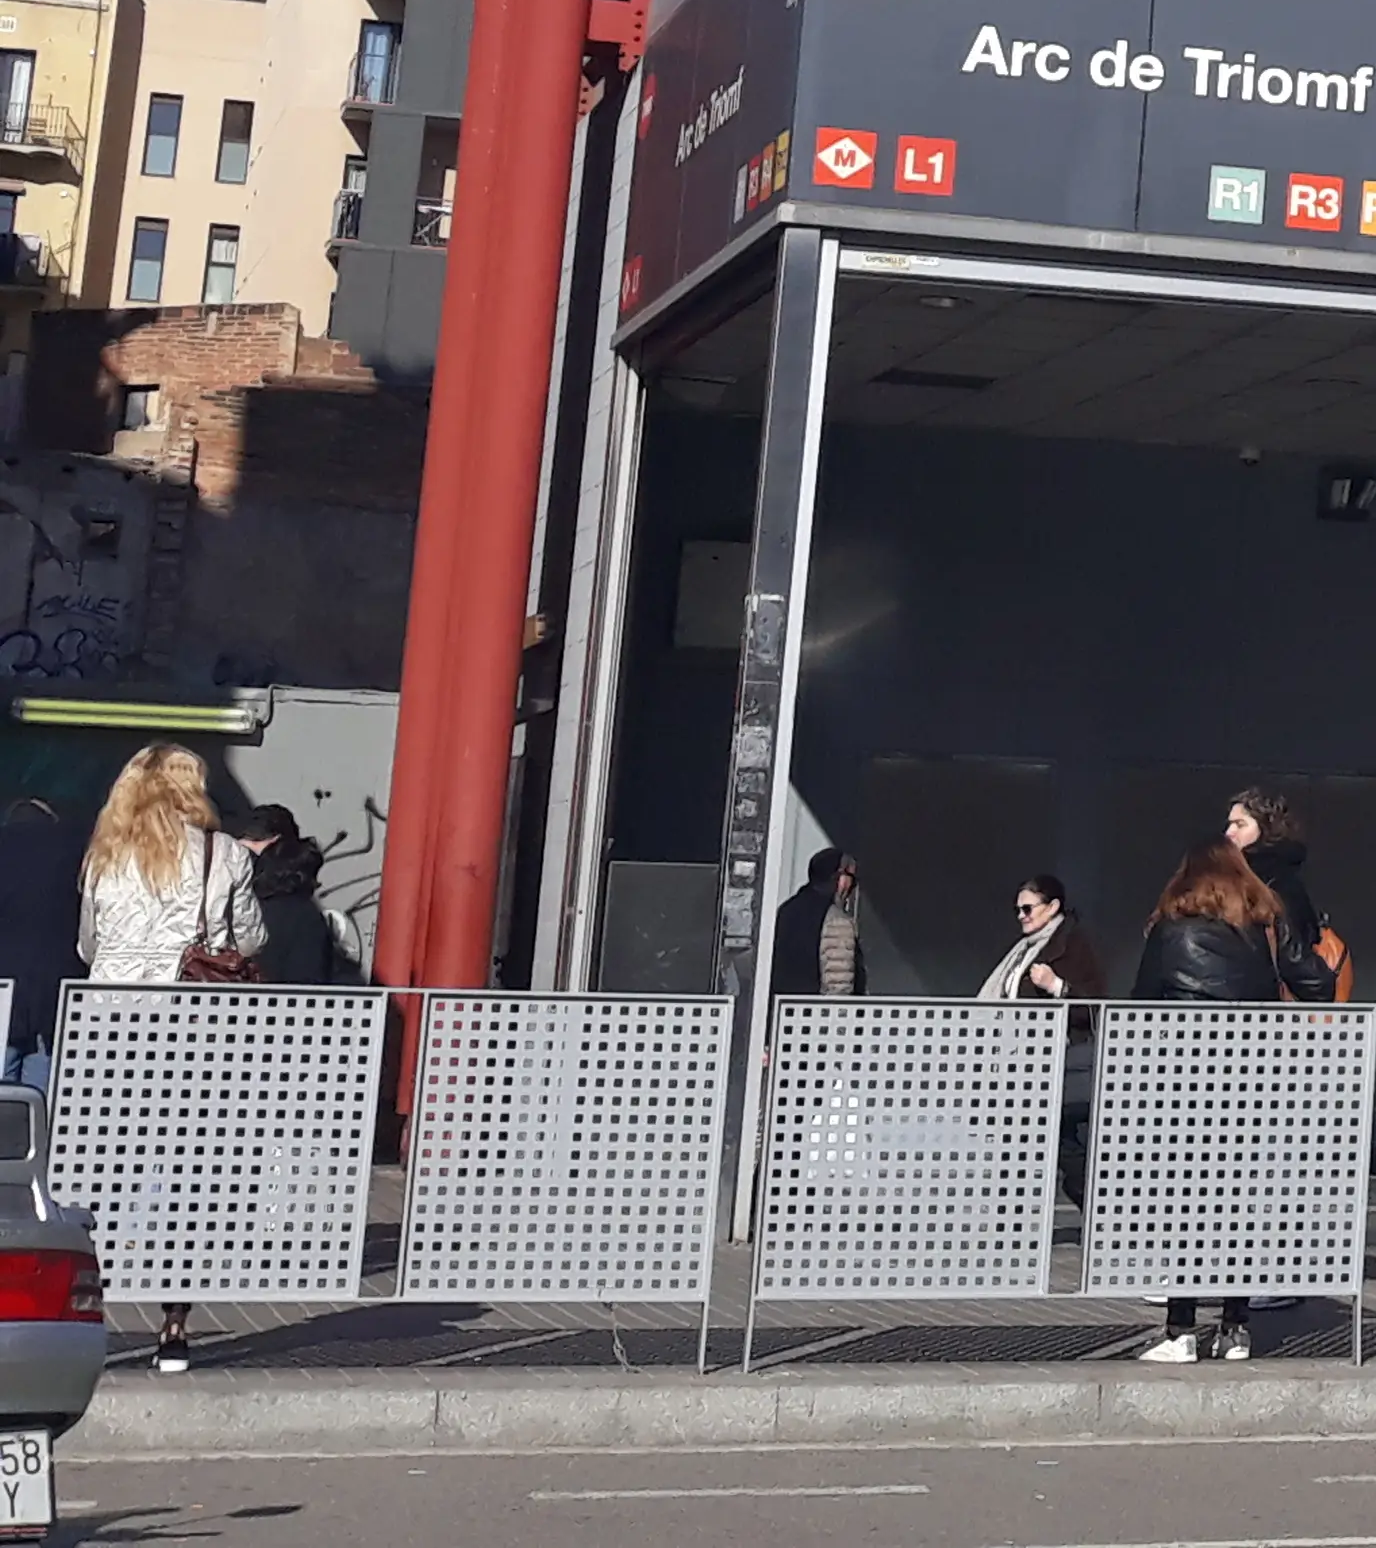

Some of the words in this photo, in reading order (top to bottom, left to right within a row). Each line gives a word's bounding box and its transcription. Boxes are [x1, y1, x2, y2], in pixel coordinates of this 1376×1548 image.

[961, 24, 1071, 82] Arc
[1089, 40, 1165, 92] de
[1183, 46, 1374, 113] Triomf
[834, 148, 856, 168] M
[904, 148, 945, 184] L1
[1213, 177, 1259, 213] R1
[1289, 184, 1340, 220] R3
